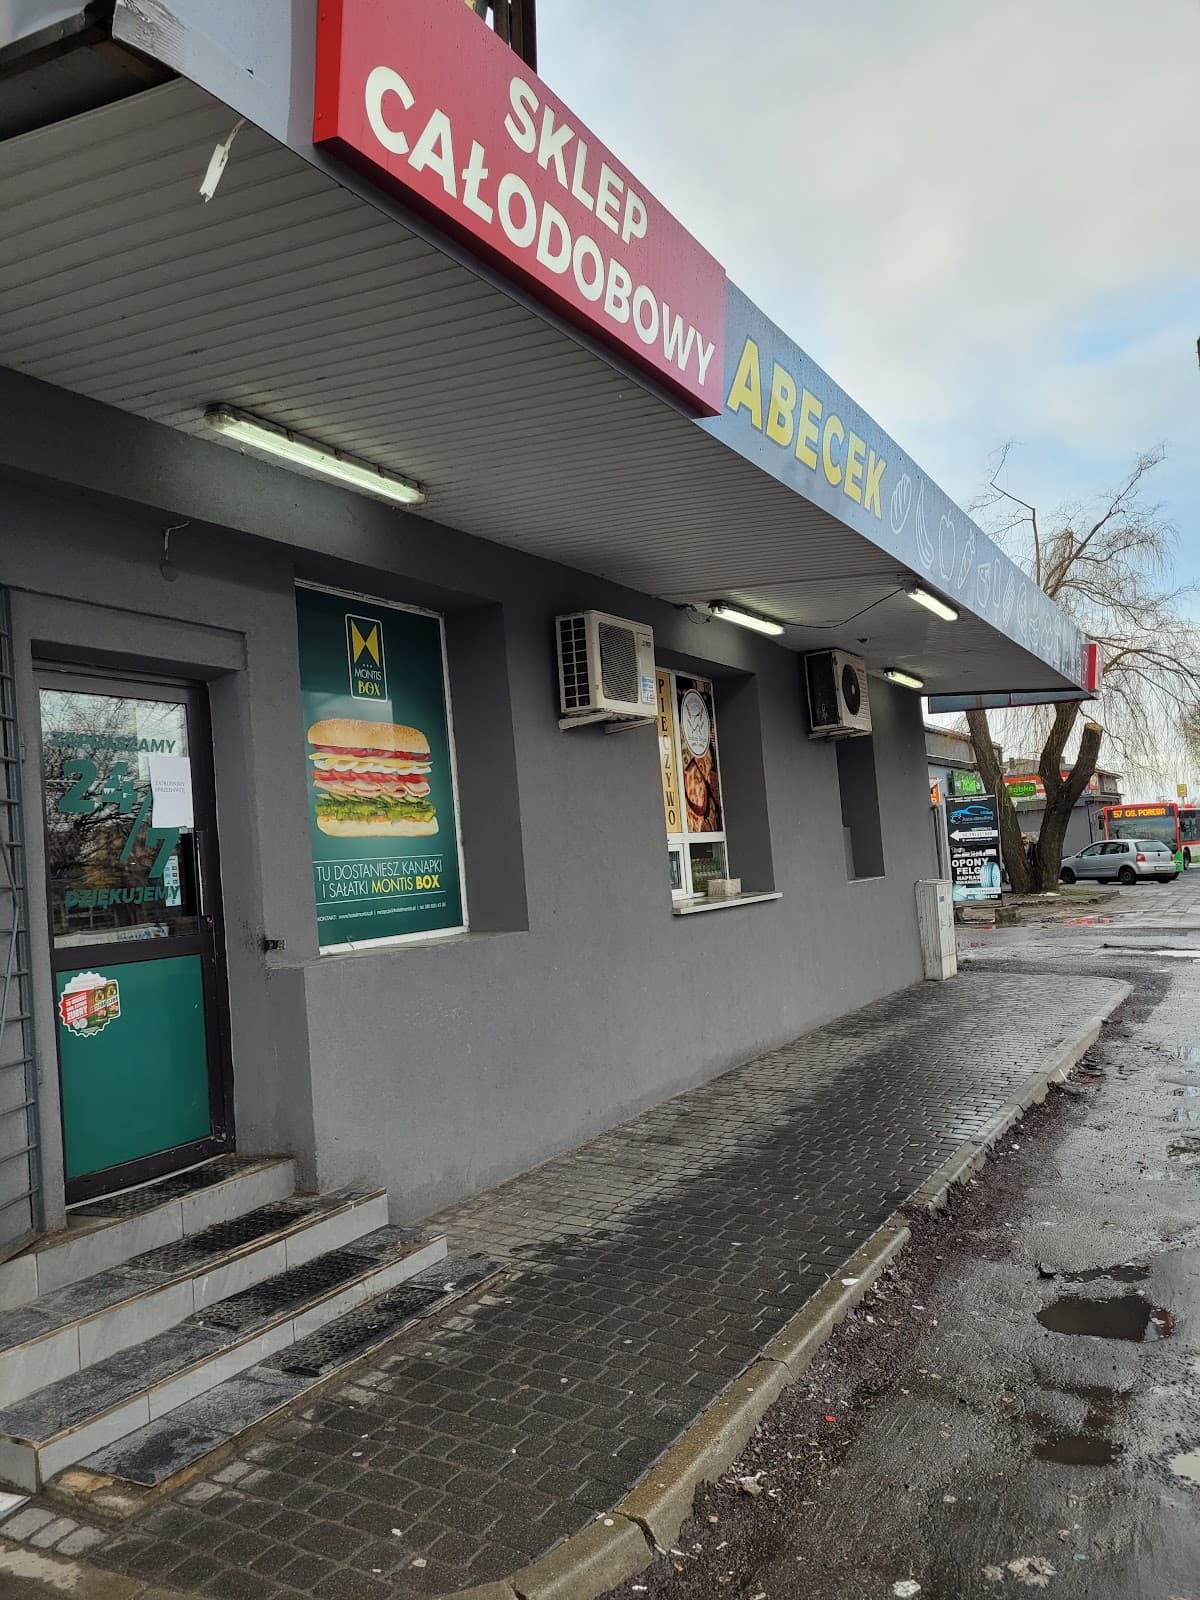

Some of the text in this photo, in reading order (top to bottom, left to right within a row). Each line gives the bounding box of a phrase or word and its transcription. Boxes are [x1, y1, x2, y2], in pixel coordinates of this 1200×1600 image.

[504, 76, 649, 244] SKLEP
[365, 66, 716, 386] CAŁODOBOWY
[726, 335, 888, 520] ABECEK
[355, 668, 382, 680] MONTIS
[358, 680, 381, 697] BOX
[1113, 810, 1123, 819] 57
[315, 859, 443, 882] TU DOSTANIESZ KANAPKI
[952, 858, 989, 867] OPONY
[65, 886, 180, 909] DZIĘKUJEMY
[329, 880, 369, 898] SAŁATKI
[371, 876, 414, 894] MONTIS
[415, 874, 441, 890] BOX
